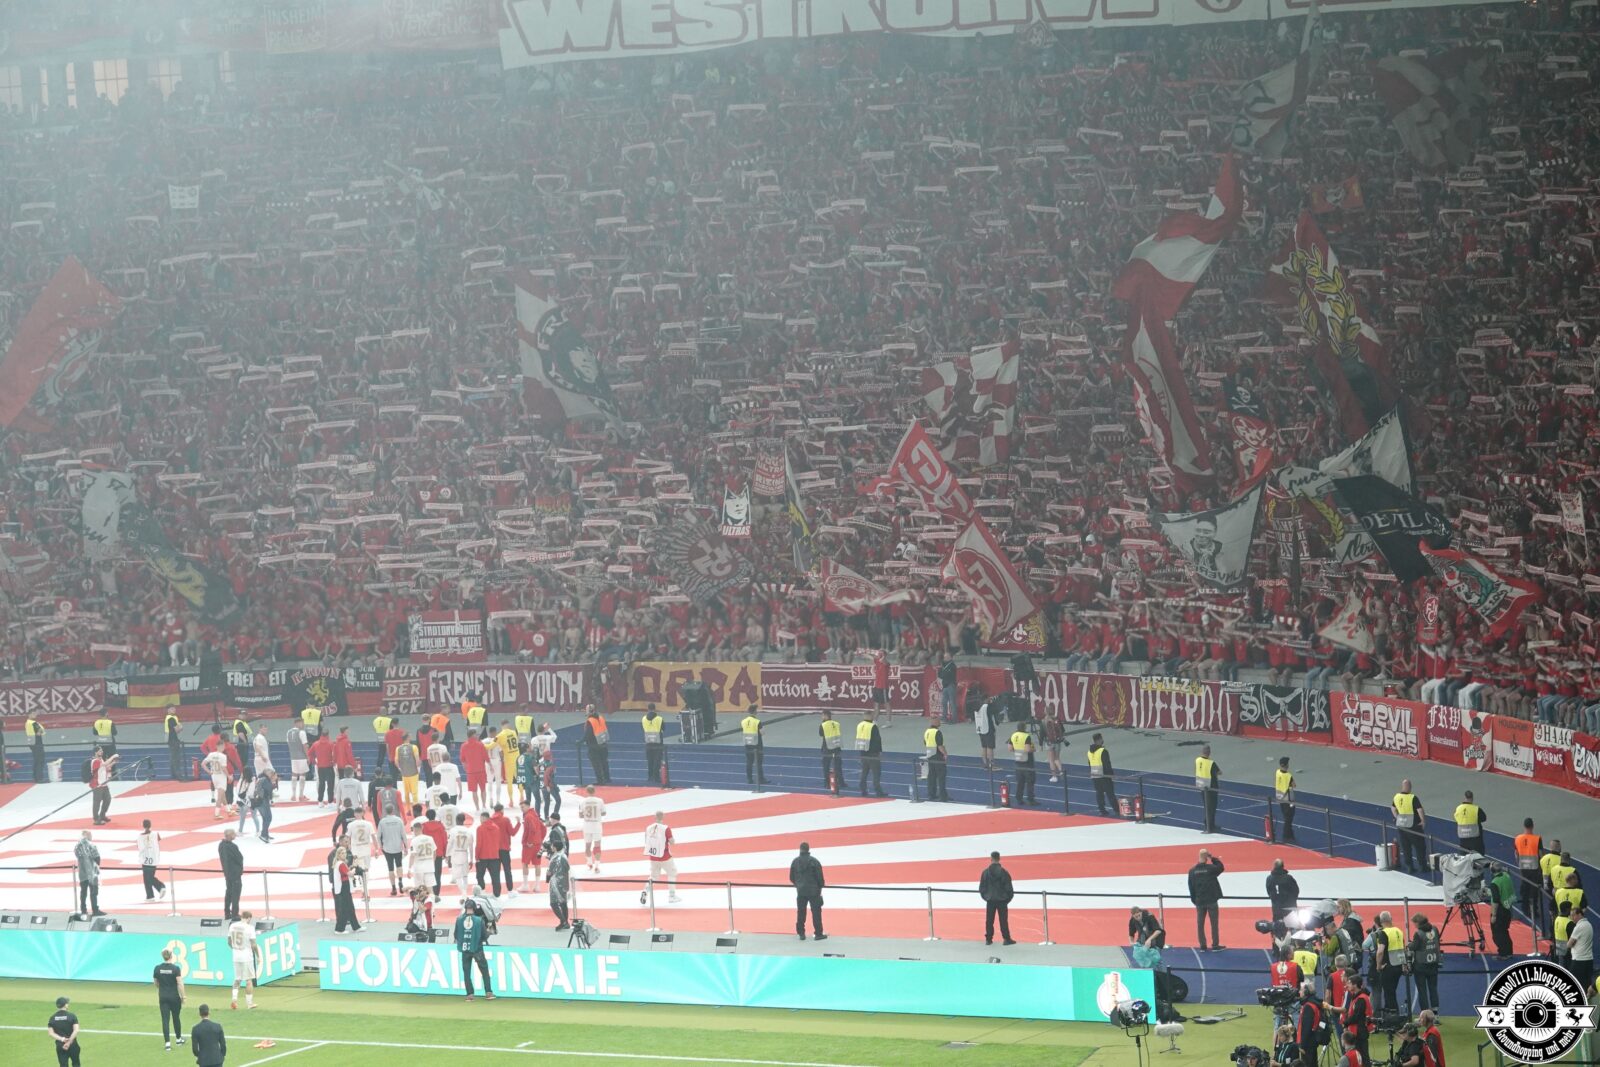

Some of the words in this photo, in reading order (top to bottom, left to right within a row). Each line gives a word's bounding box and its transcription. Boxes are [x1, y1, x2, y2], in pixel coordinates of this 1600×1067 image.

[721, 525, 751, 536] ULTRAS
[385, 665, 420, 678] NUR
[852, 666, 873, 677] SEK
[386, 682, 421, 696] DER
[523, 670, 583, 706] YOUTH
[761, 678, 811, 698] ration
[838, 680, 895, 702] Luzir
[387, 701, 422, 715] FCK
[507, 738, 518, 750] 18
[429, 751, 441, 763] 10
[585, 806, 597, 819] 31
[357, 828, 366, 842] 2
[456, 835, 468, 849] 17
[418, 843, 432, 857] 26
[144, 857, 154, 865] 20
[232, 931, 245, 946] 15
